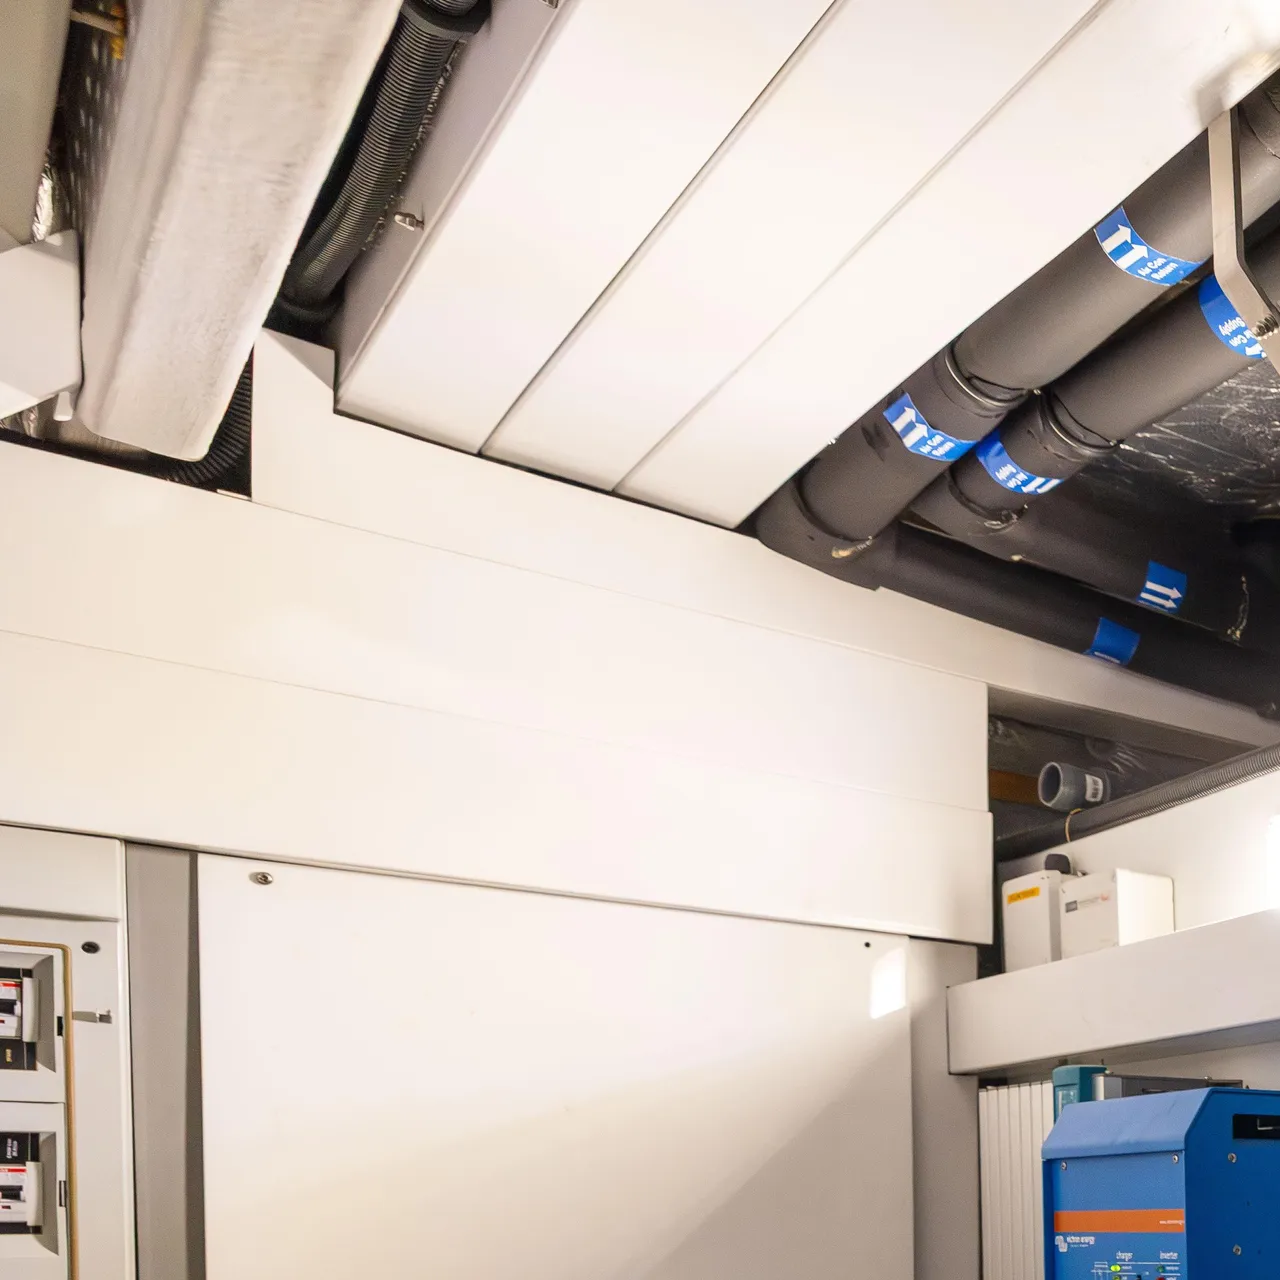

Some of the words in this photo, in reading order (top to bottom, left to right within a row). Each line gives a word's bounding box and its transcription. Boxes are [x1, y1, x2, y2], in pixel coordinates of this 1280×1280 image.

[1146, 257, 1167, 271] Con
[1151, 262, 1179, 280] Return
[1218, 316, 1246, 336] Supply
[1229, 333, 1248, 347] Con
